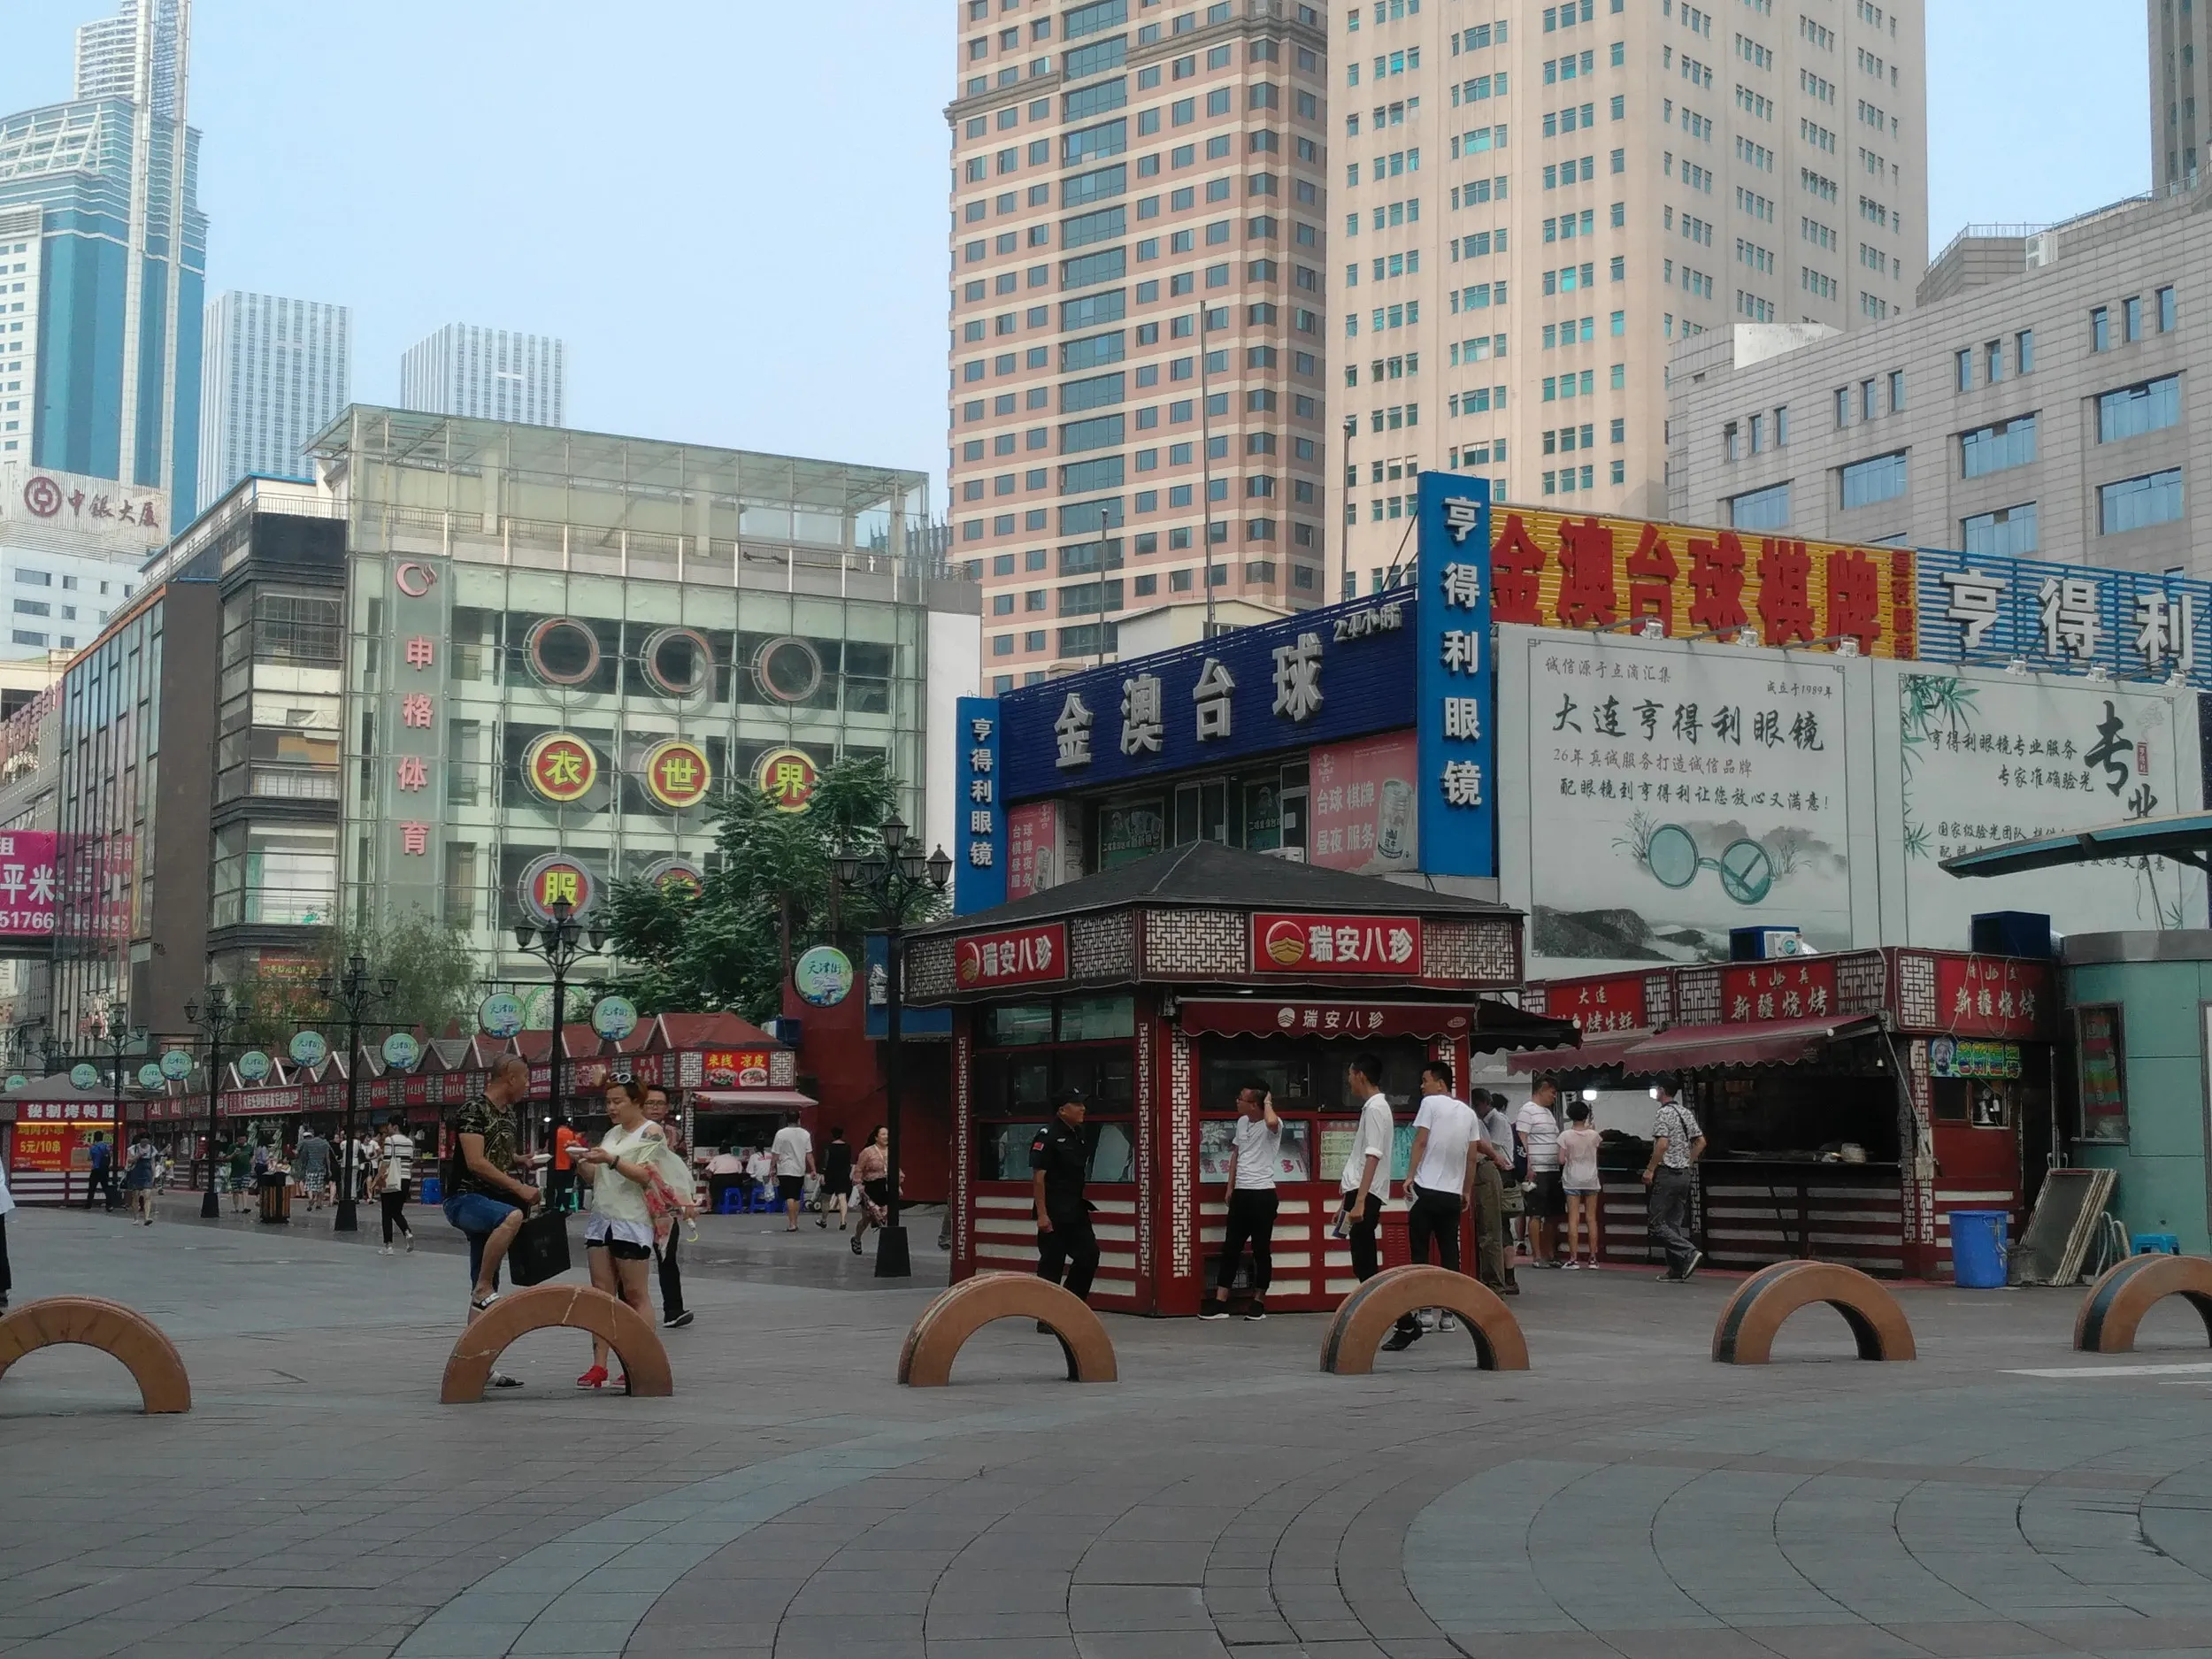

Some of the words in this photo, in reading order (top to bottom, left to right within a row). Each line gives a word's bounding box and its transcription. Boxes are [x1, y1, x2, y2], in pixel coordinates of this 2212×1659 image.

[1490, 512, 1881, 657] 金澳台球棋牌
[1939, 567, 2193, 671] 亨得利
[1444, 496, 1482, 806] 亨得利眼镜
[1054, 632, 1325, 768] 金澳台球
[1552, 693, 1824, 751] 大连亨得利眼镜
[397, 635, 434, 856] 申格体育
[1929, 729, 2078, 760] 亨得利眼镜专业服务
[971, 718, 994, 866] 亨得利眼镜
[1998, 764, 2094, 791] 专家准确验光
[982, 935, 1052, 977] 瑞安八珍
[1309, 925, 1413, 964] 瑞安八珍
[808, 960, 841, 974] 天津街
[1578, 987, 1608, 1004] 大连
[1732, 986, 1828, 1023] 新疆烧烤
[1302, 1010, 1385, 1029] 瑞安八珍
